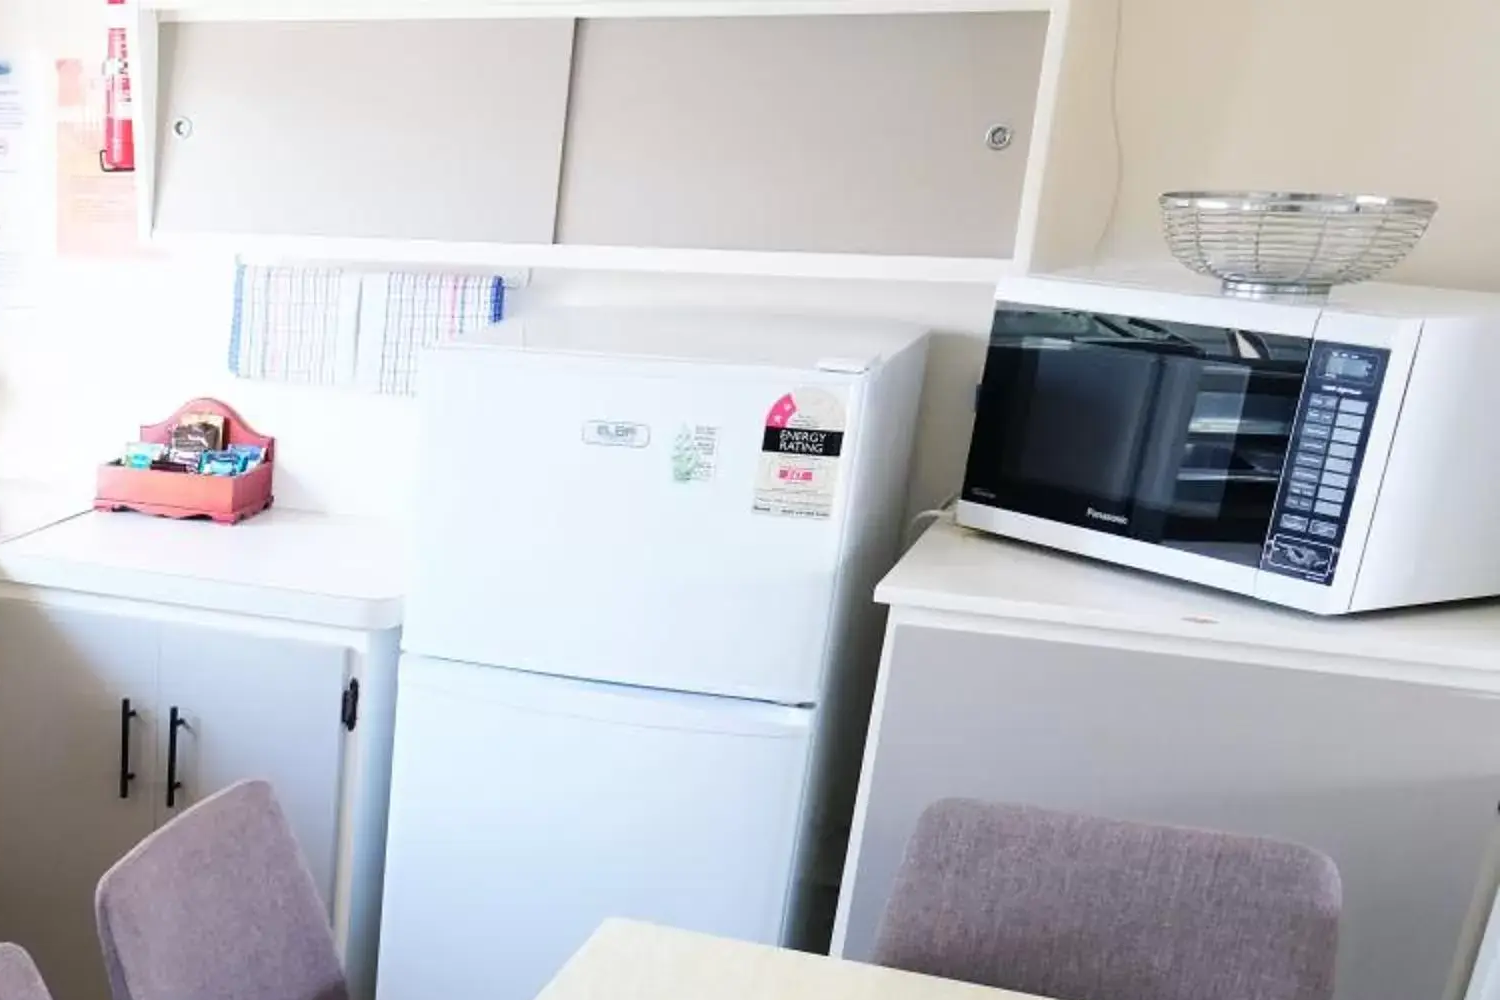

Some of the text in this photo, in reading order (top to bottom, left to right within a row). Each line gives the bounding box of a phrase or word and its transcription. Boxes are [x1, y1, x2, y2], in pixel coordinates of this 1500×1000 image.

[779, 430, 827, 443] ENERGY
[779, 441, 825, 453] RATING
[1085, 506, 1129, 525] Panasonic
